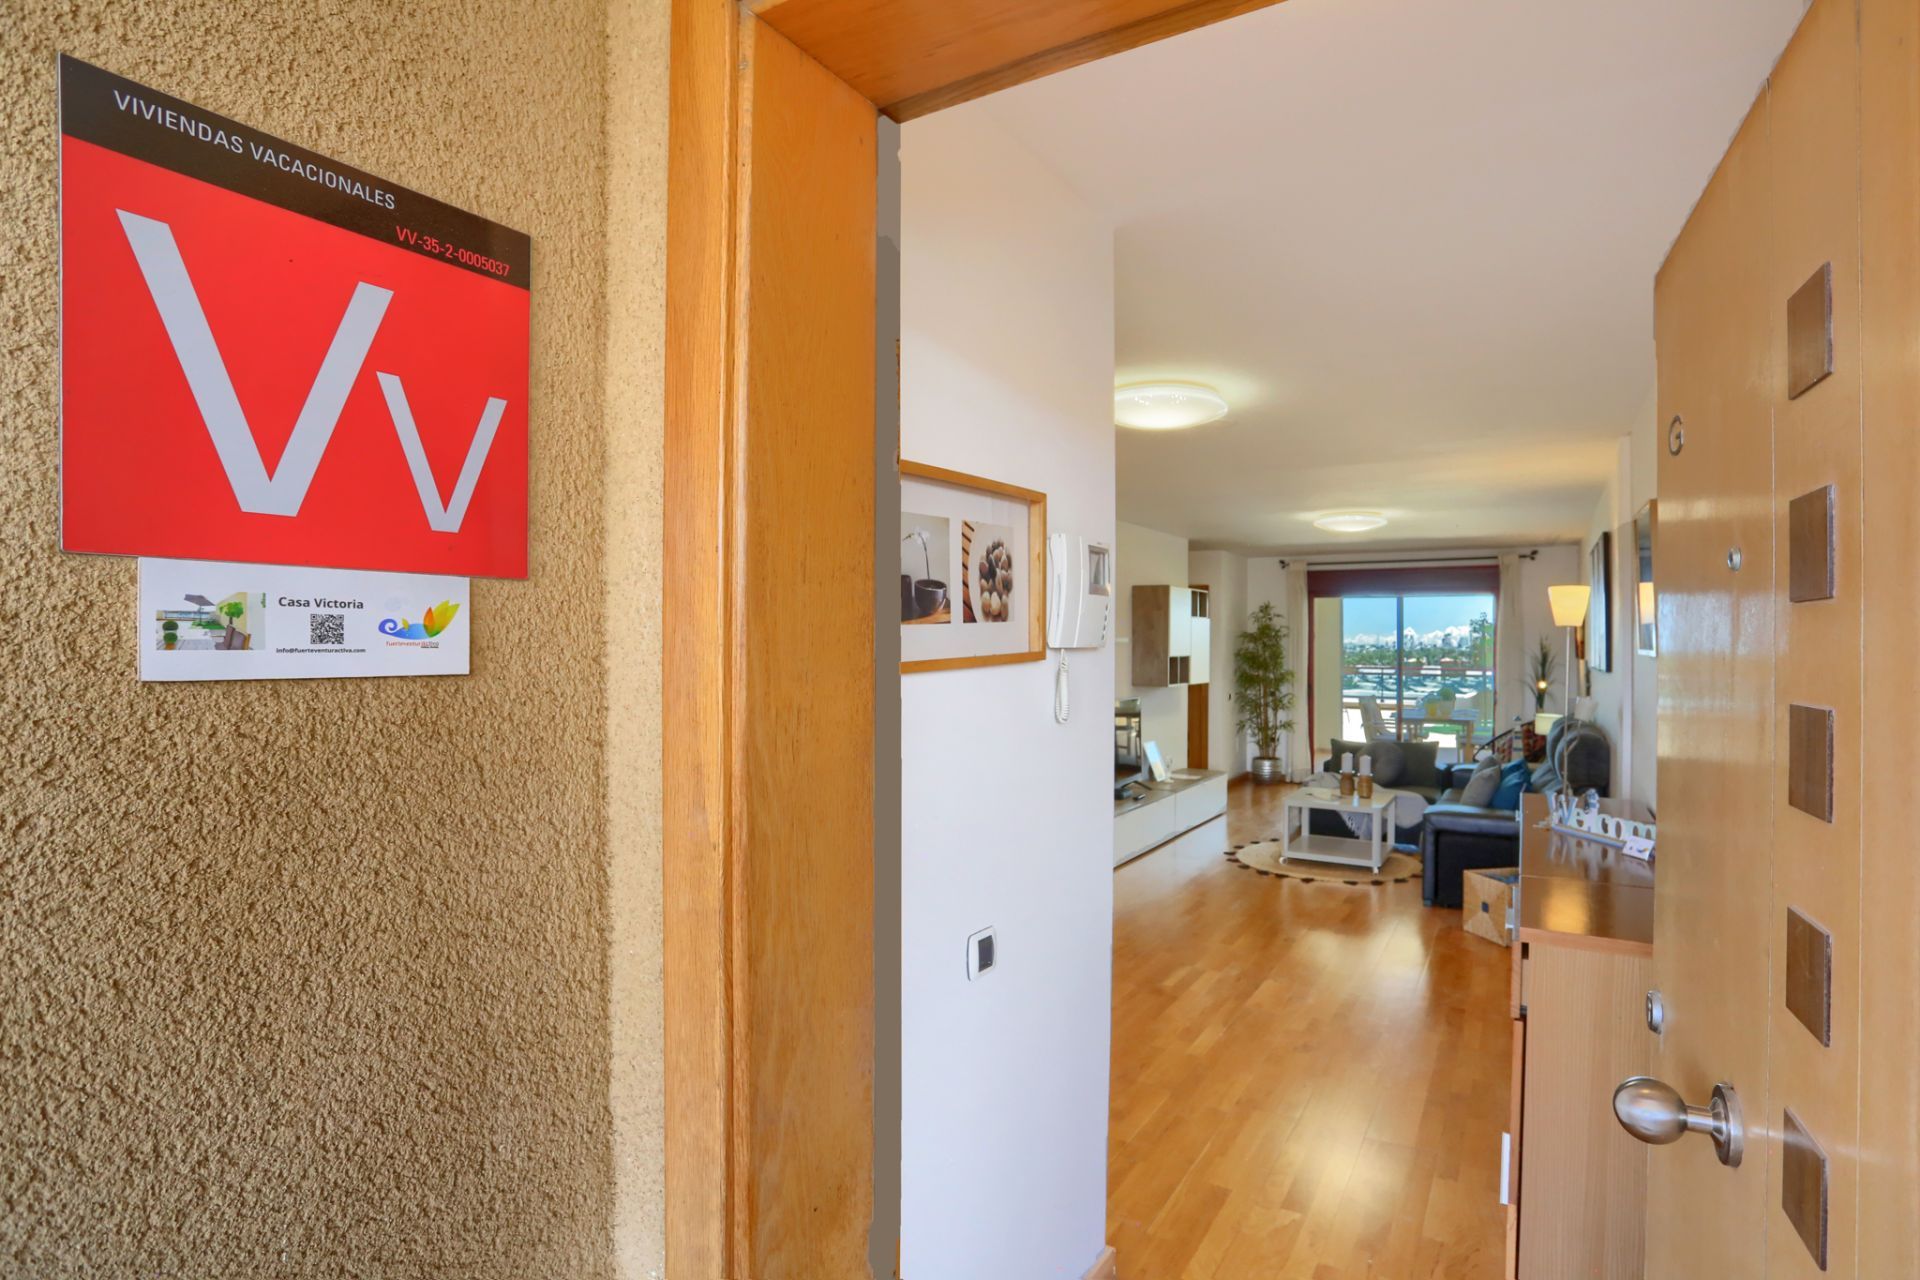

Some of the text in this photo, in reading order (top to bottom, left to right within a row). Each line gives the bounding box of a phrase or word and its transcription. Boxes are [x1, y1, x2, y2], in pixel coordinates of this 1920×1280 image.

[112, 89, 396, 210] VIVIENDAS VACACIONALES
[395, 226, 511, 278] VV-35-2-0005037
[1668, 415, 1685, 456] G
[278, 596, 364, 609] Casa Victoria
